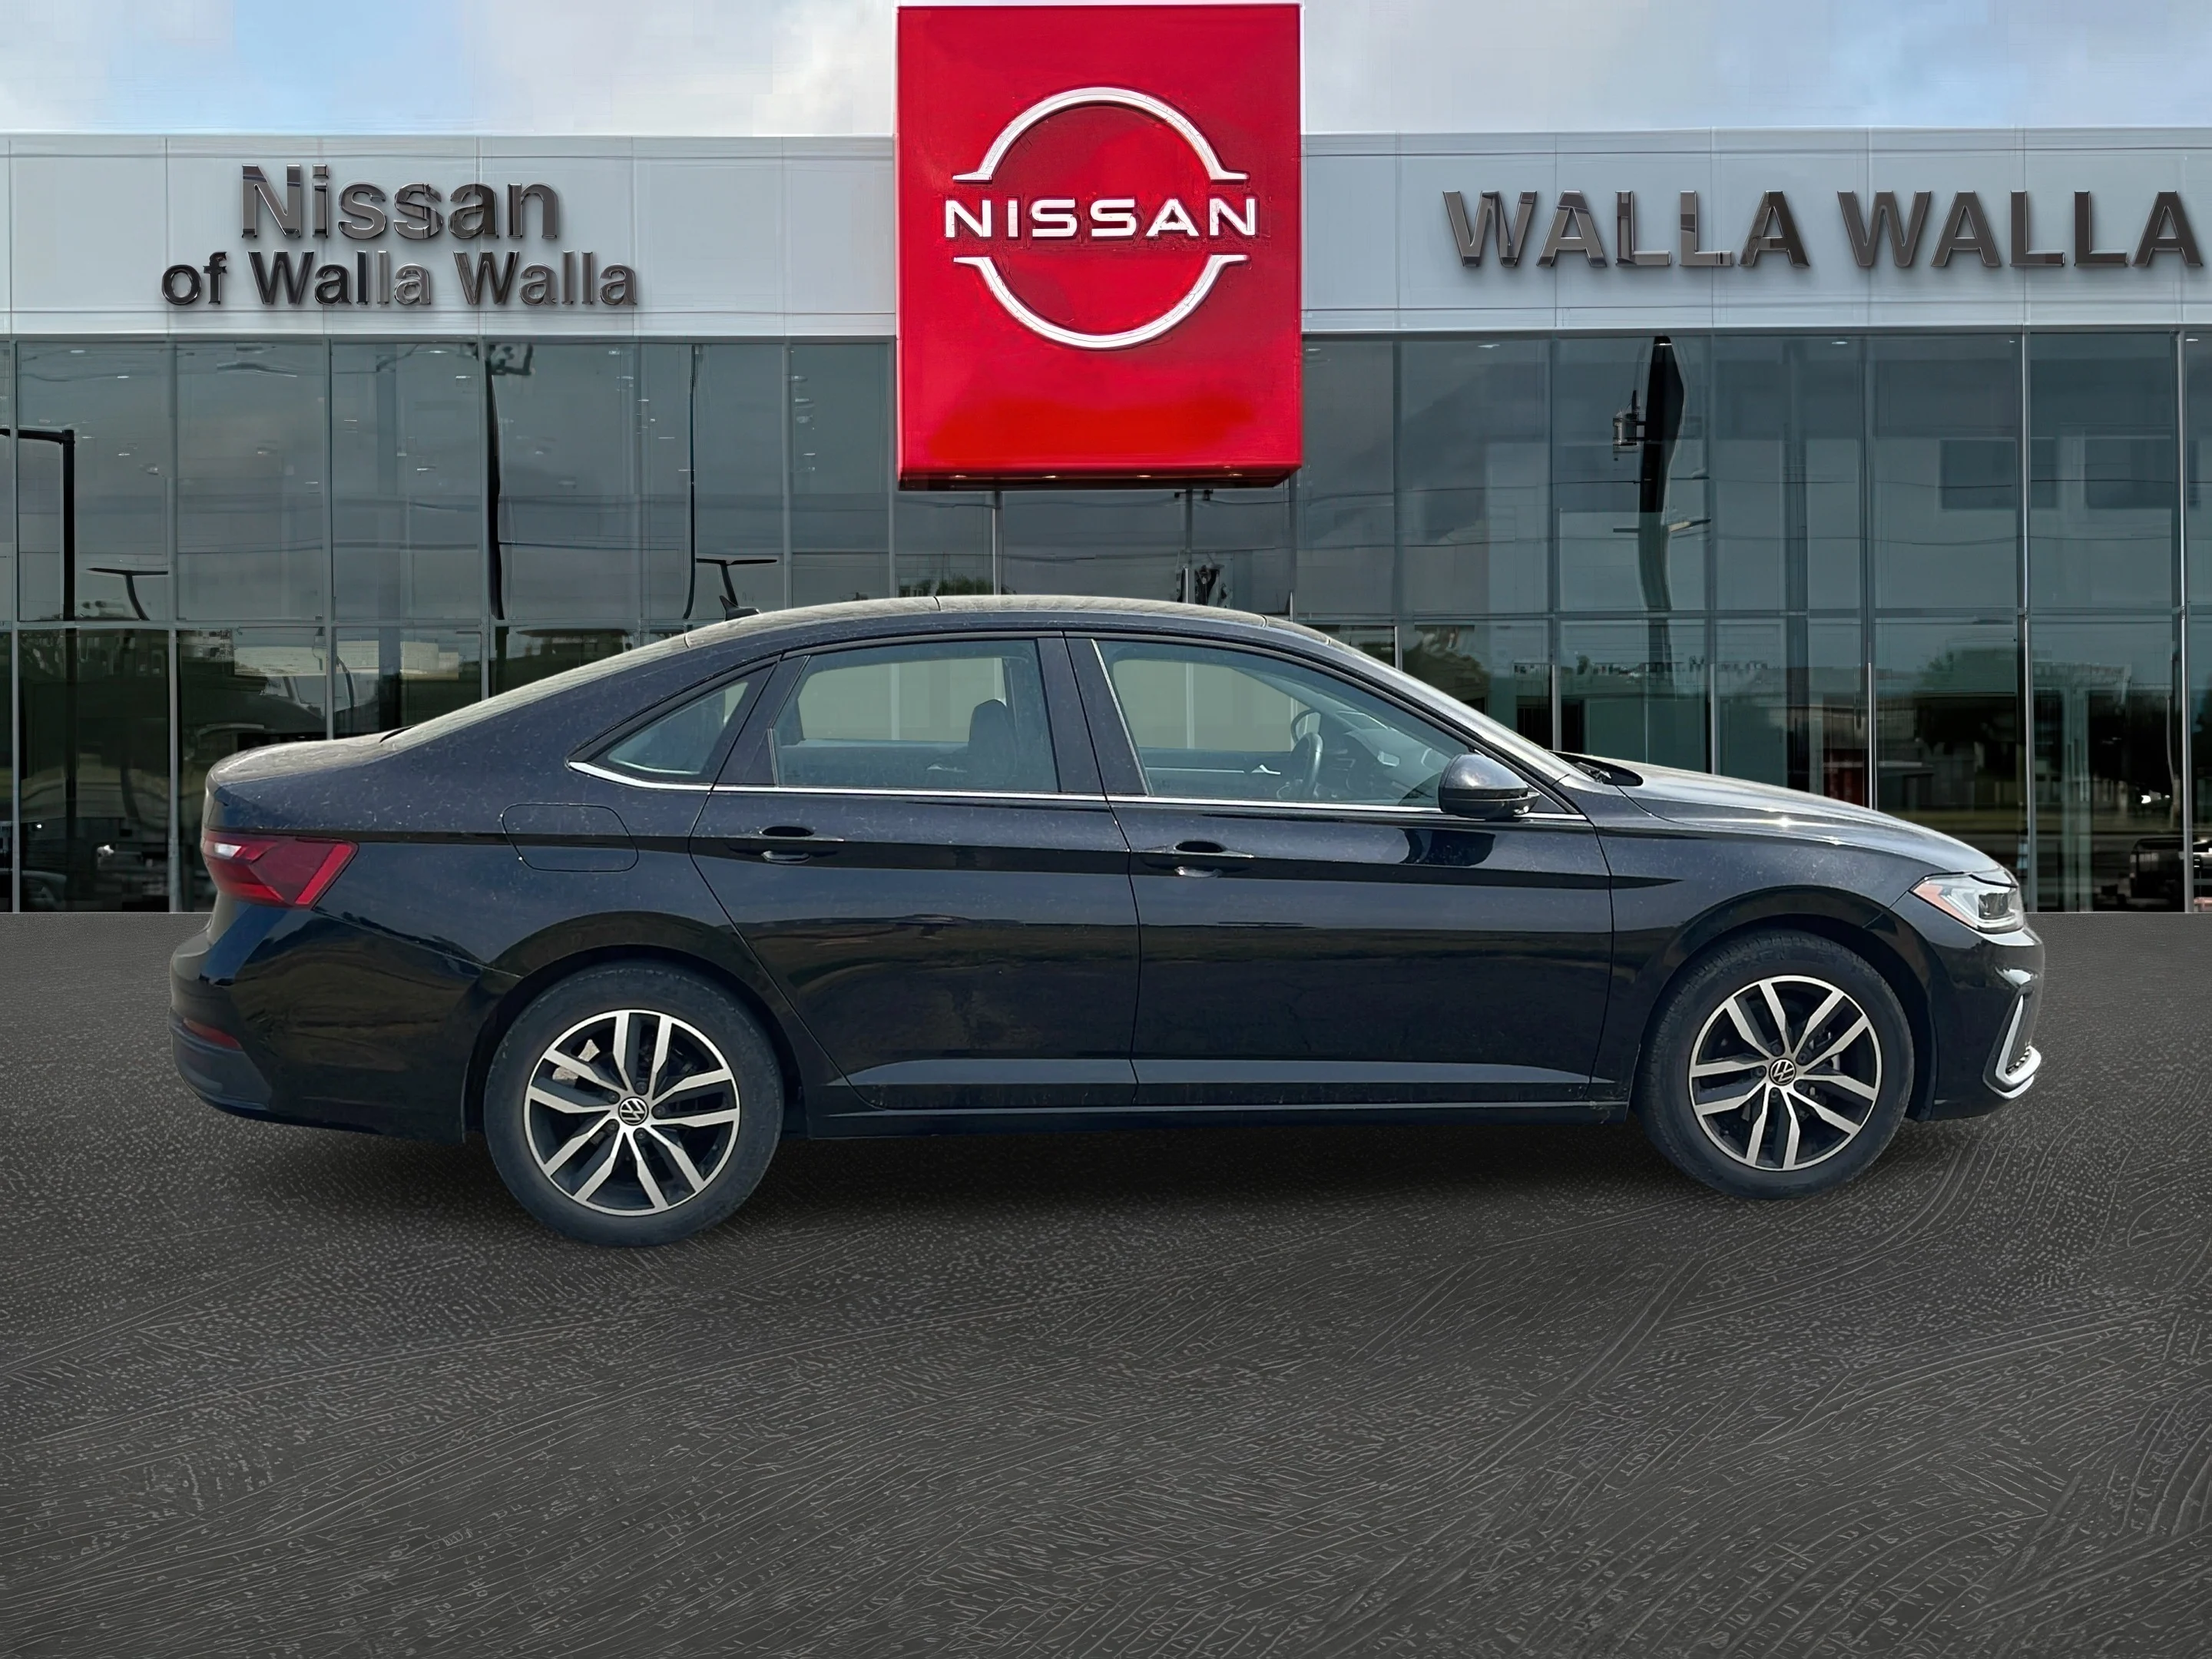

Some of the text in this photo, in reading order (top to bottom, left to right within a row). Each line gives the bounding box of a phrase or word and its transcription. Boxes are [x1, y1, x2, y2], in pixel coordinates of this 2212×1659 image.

[241, 163, 560, 239] Nissan
[945, 197, 1257, 238] NISSAN
[1442, 190, 2204, 268] WALLA WALLA
[161, 250, 639, 306] of Walla Walla
